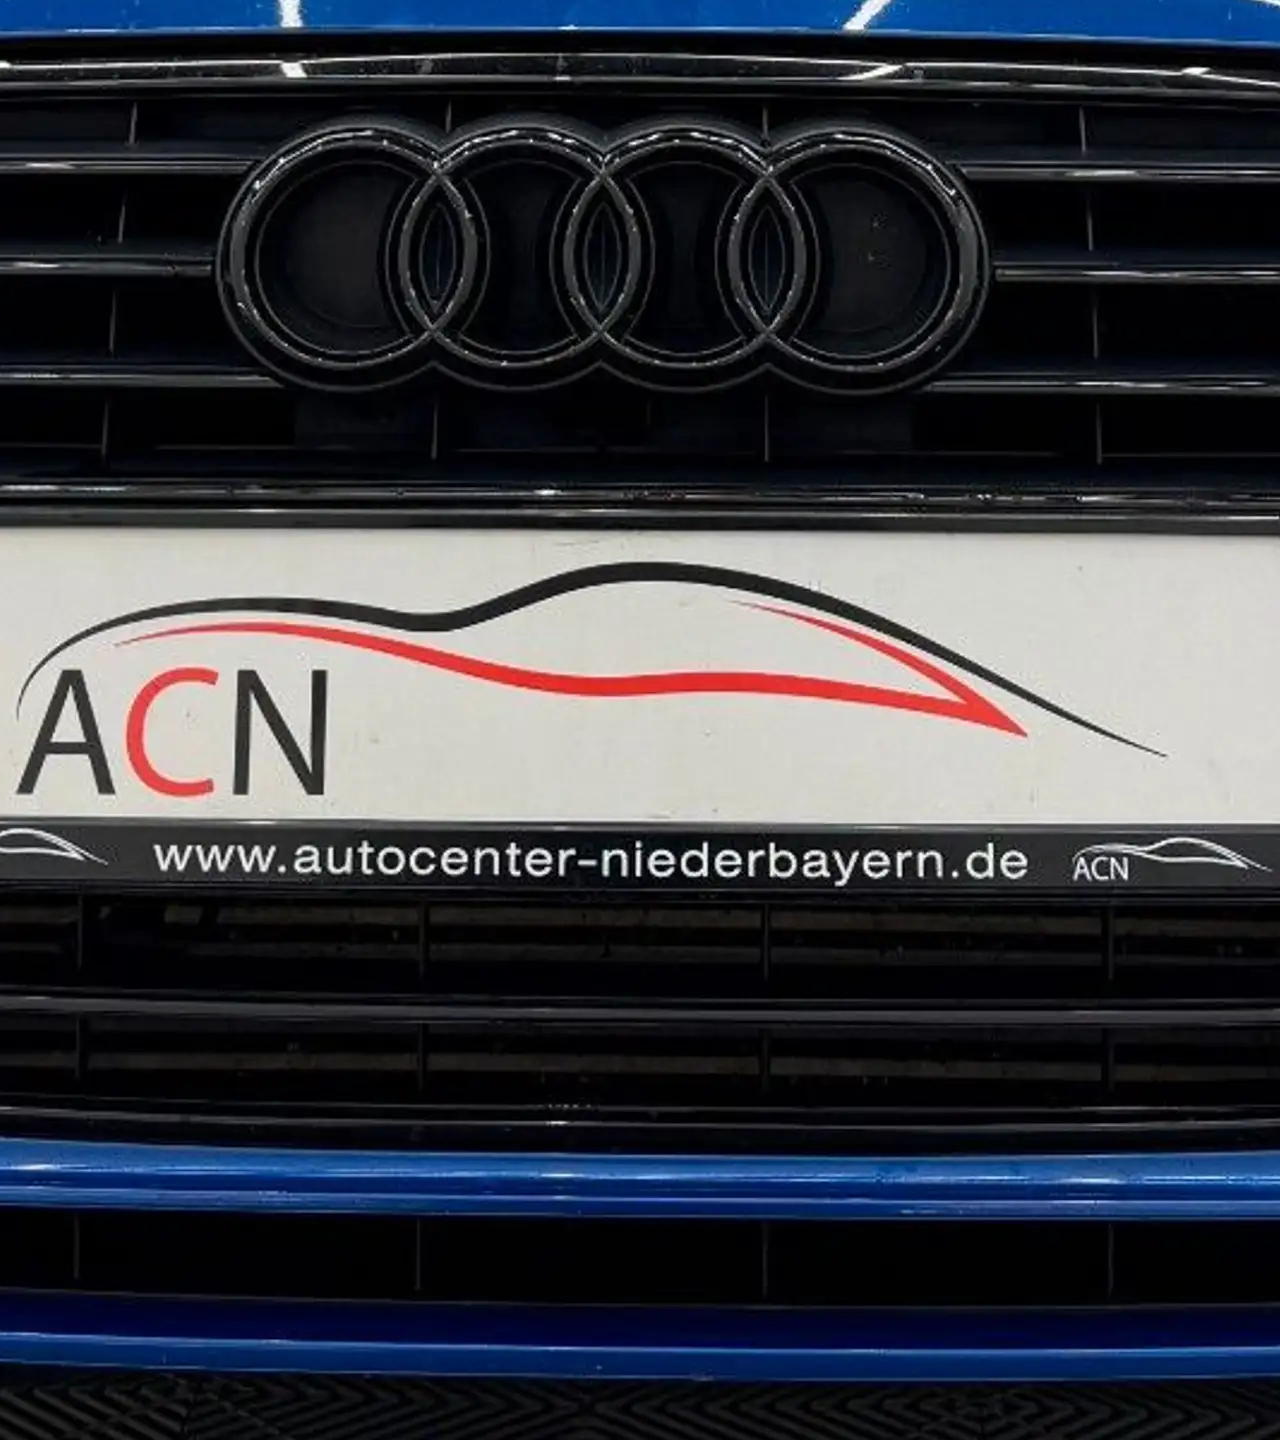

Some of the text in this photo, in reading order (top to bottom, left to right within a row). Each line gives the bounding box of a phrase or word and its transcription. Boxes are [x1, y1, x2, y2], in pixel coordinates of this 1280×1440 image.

[16, 667, 327, 797] ACN
[153, 840, 1029, 887] www.autocenter-niederbayern.de
[1072, 856, 1129, 882] ACN
